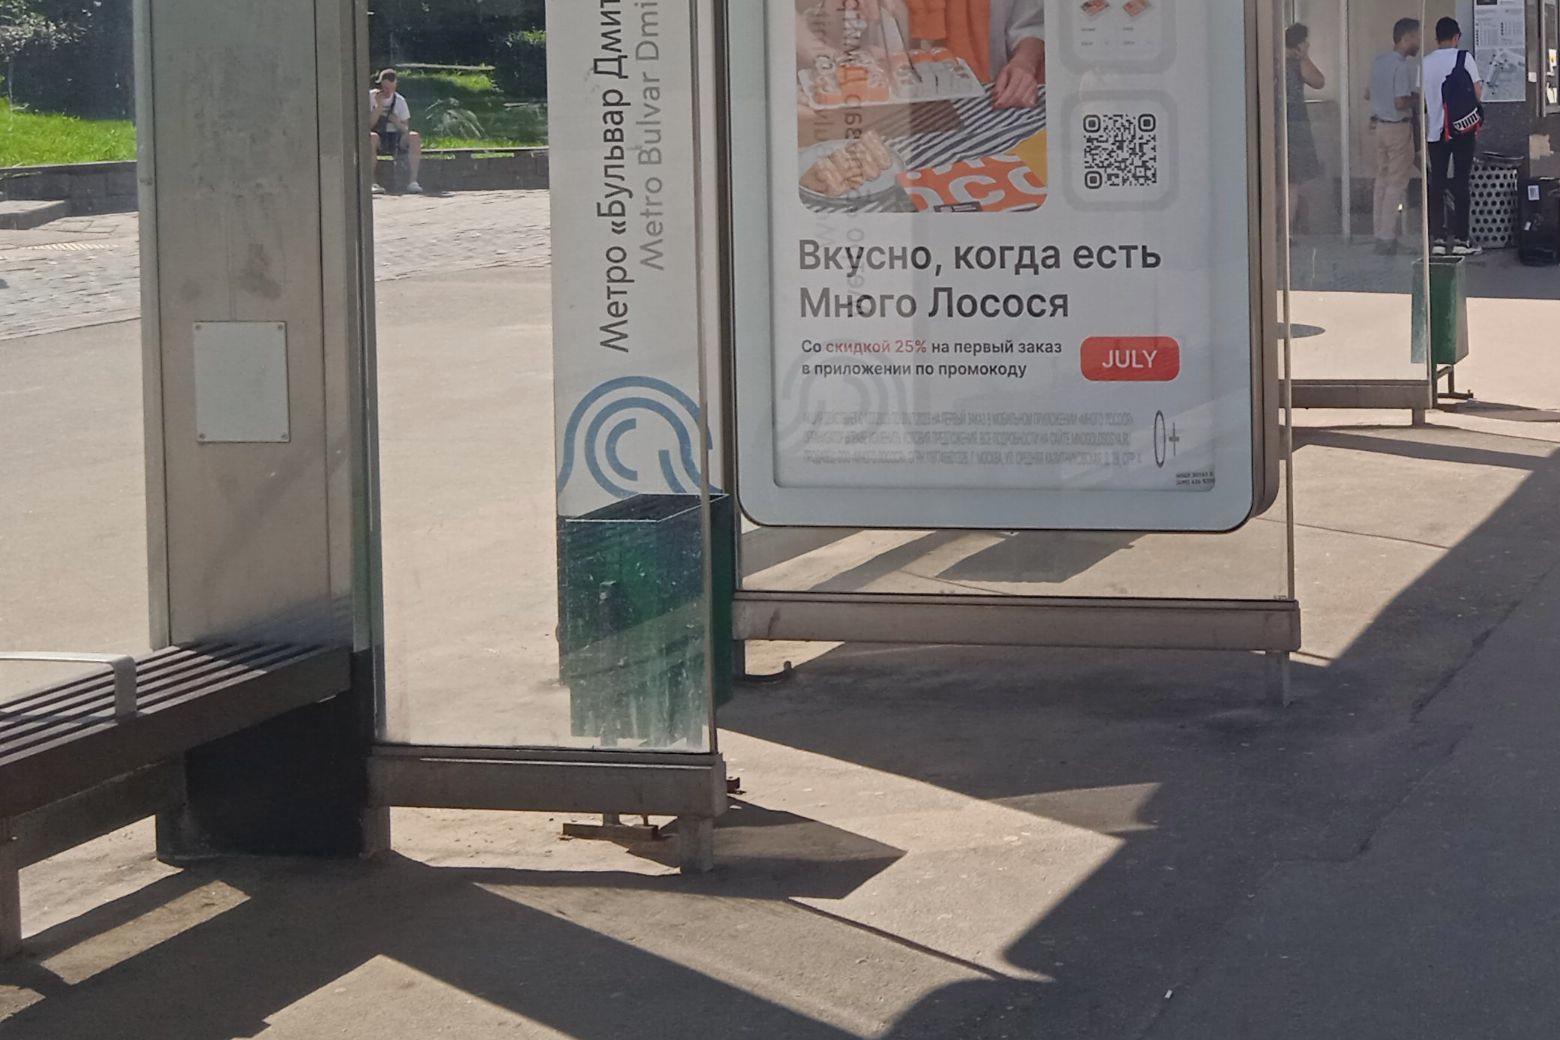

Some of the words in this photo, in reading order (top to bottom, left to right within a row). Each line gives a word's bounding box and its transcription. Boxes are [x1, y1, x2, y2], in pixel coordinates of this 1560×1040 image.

[637, 70, 662, 165] Bulvar
[597, 88, 634, 235] «Бульвар
[639, 176, 664, 271] Metro
[799, 239, 943, 277] Вкусно,
[954, 244, 1060, 275] когда
[1072, 245, 1161, 270] есть
[600, 245, 635, 353] Метро
[799, 287, 916, 318] Много
[928, 287, 1069, 318] Лосося
[801, 340, 822, 353] Со
[826, 339, 891, 356] скидкой
[895, 339, 927, 353] 25%
[931, 342, 950, 353] на
[954, 338, 1014, 357] первый
[1019, 341, 1062, 353] заказ
[1102, 350, 1158, 369] JULY
[802, 364, 810, 375] в
[815, 363, 911, 379] приложении
[915, 364, 935, 375] по
[939, 364, 1027, 379] промокоду
